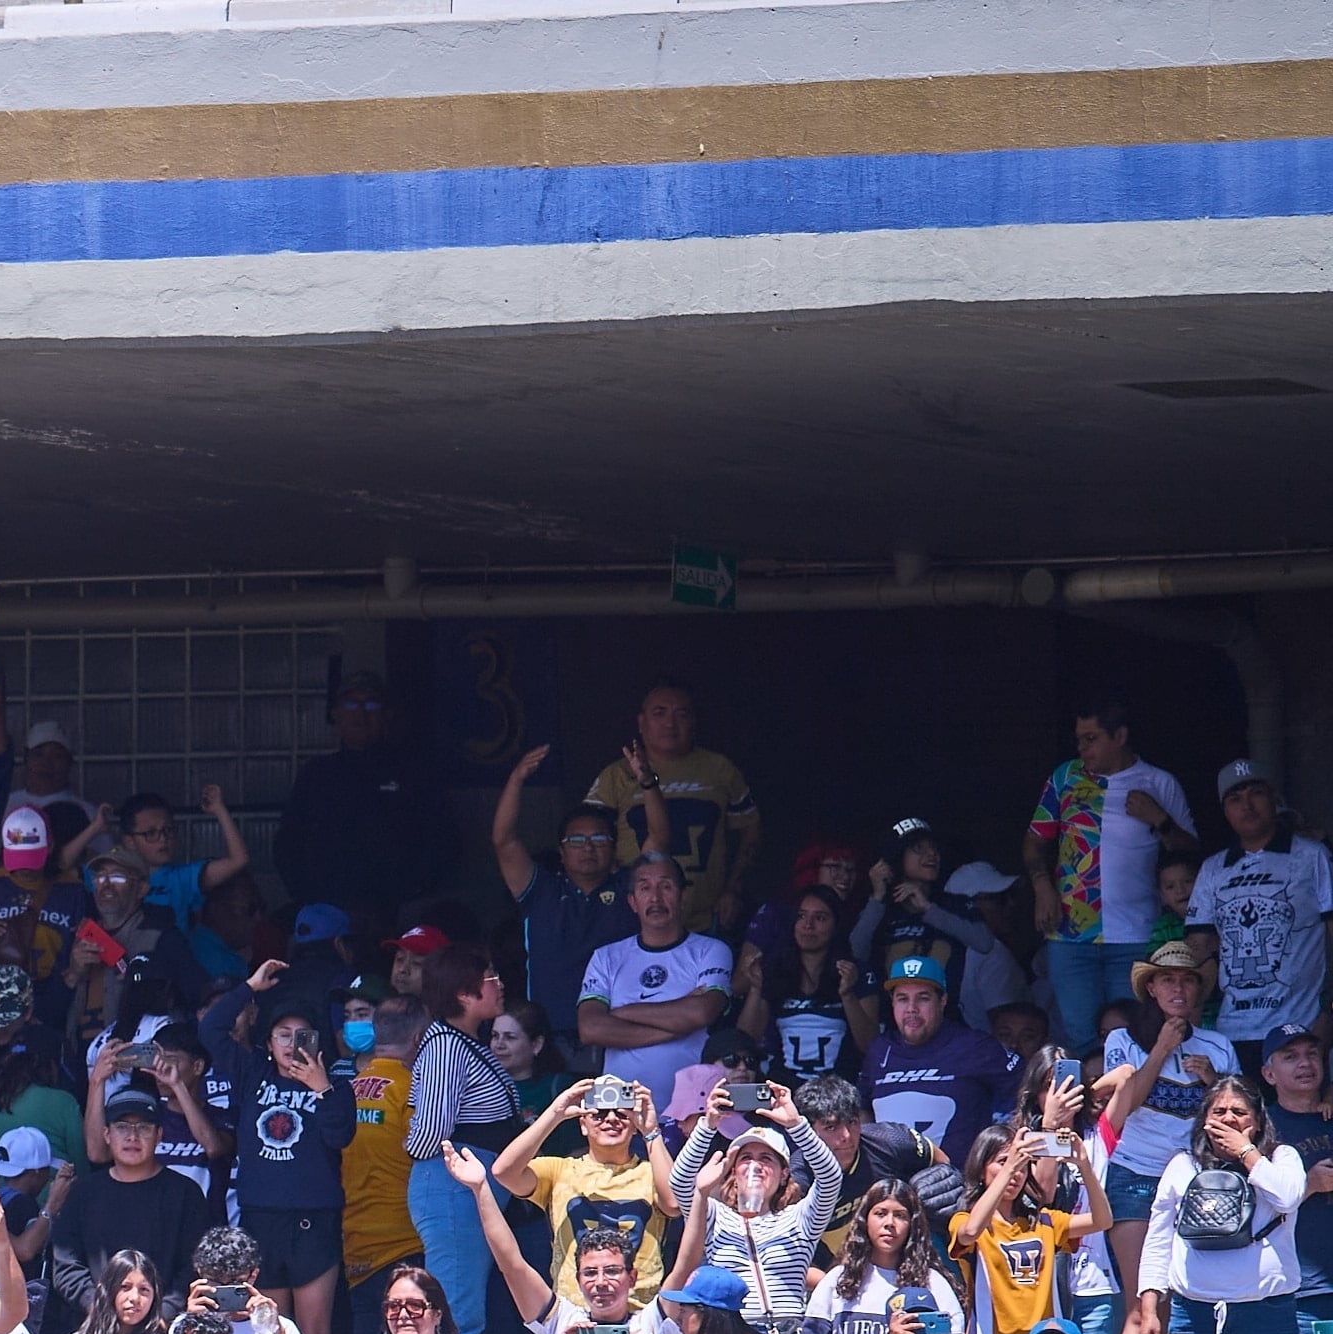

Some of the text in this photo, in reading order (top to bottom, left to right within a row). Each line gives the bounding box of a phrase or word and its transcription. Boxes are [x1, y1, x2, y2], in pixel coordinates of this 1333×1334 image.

[1227, 872, 1273, 888] DHL
[882, 1068, 941, 1084] DHL
[258, 1145, 295, 1161] ITALIA
